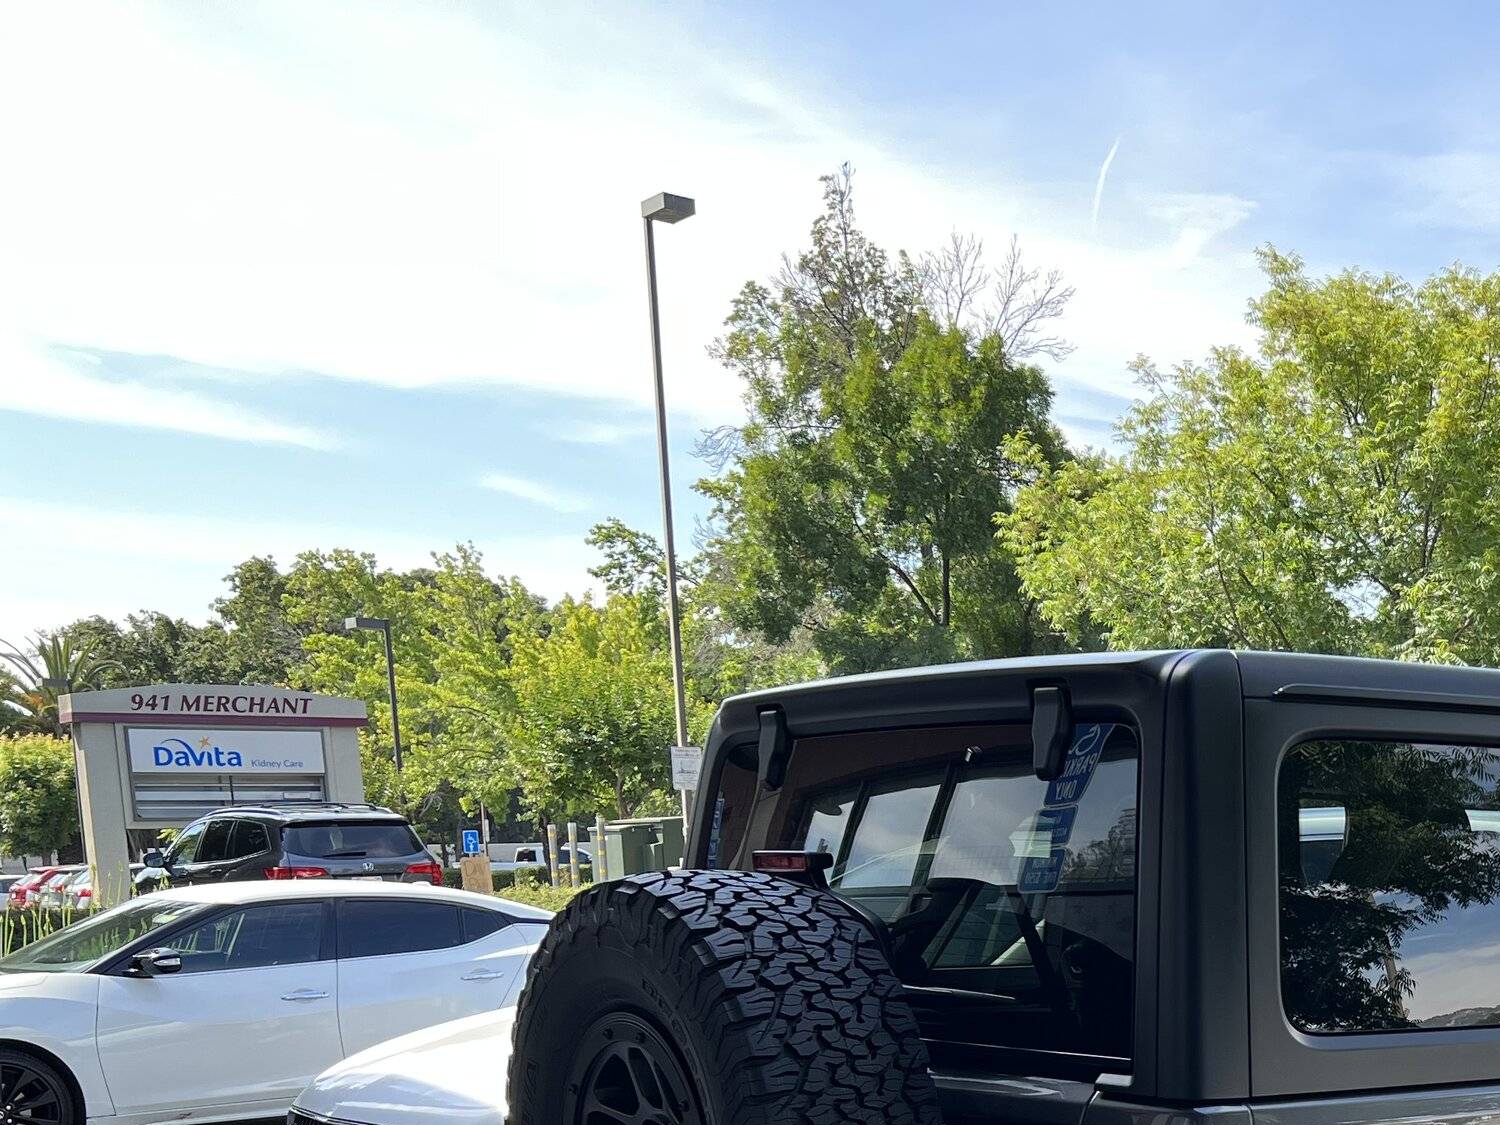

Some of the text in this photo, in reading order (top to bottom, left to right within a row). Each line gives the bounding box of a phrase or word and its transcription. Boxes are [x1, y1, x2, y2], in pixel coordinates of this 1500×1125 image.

[131, 693, 313, 715] 941 MERCHANT
[153, 739, 304, 769] DaVita Kidney Care
